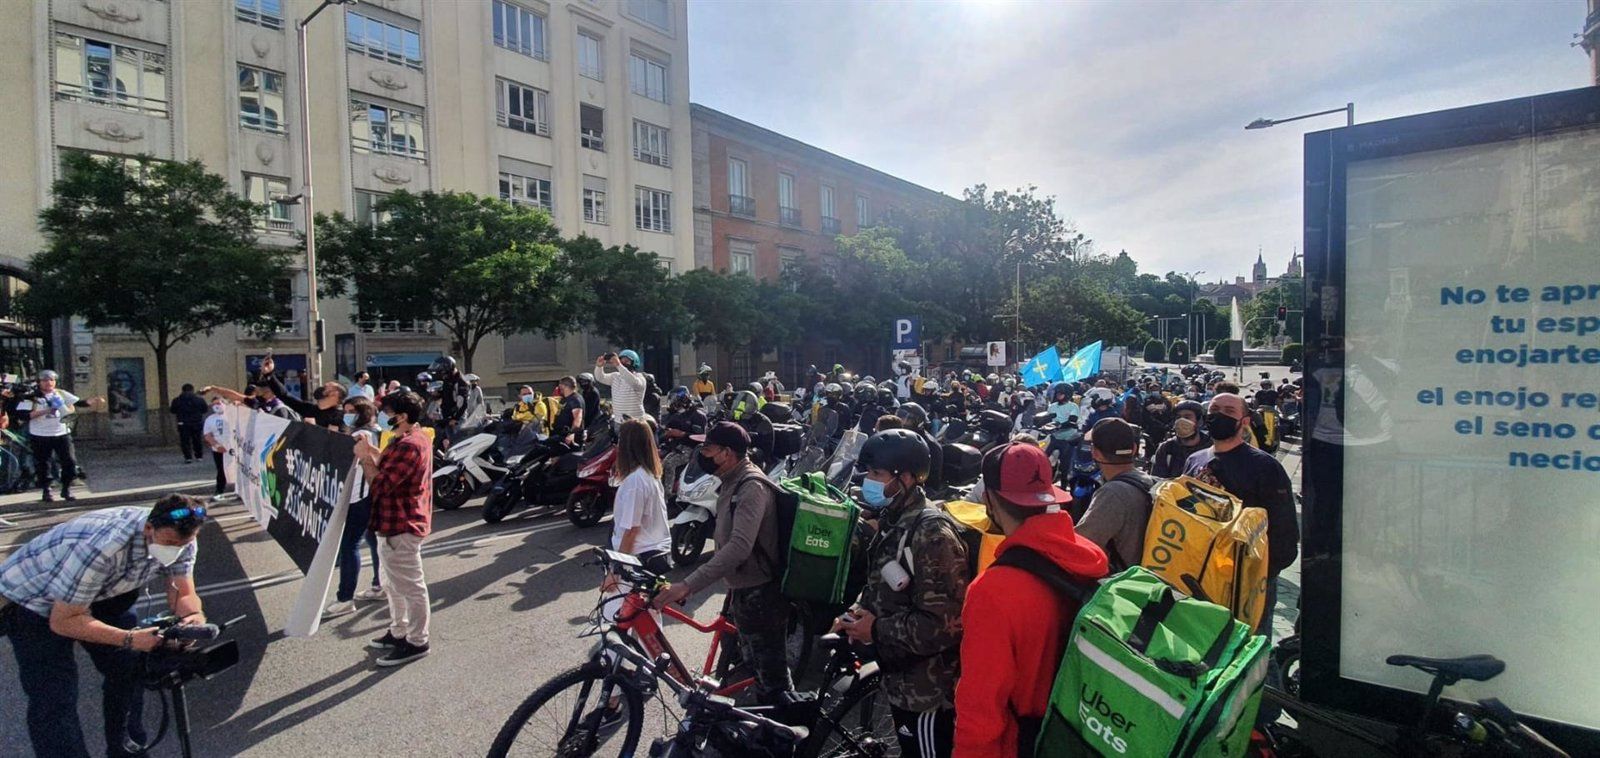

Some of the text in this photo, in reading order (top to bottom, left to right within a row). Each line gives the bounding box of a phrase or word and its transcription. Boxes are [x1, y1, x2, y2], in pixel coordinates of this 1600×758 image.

[1440, 283, 1600, 305] No te apr
[896, 319, 912, 343] P
[1491, 315, 1600, 336] tu esp
[1455, 344, 1600, 367] enojarte
[1417, 387, 1600, 412] el enojo re
[1454, 416, 1483, 435] el
[1493, 421, 1576, 439] seno
[1509, 450, 1600, 472] necio
[807, 523, 832, 537] Uber
[805, 535, 830, 549] Eats
[1081, 683, 1137, 733] Uber
[1079, 701, 1128, 754] Eats
